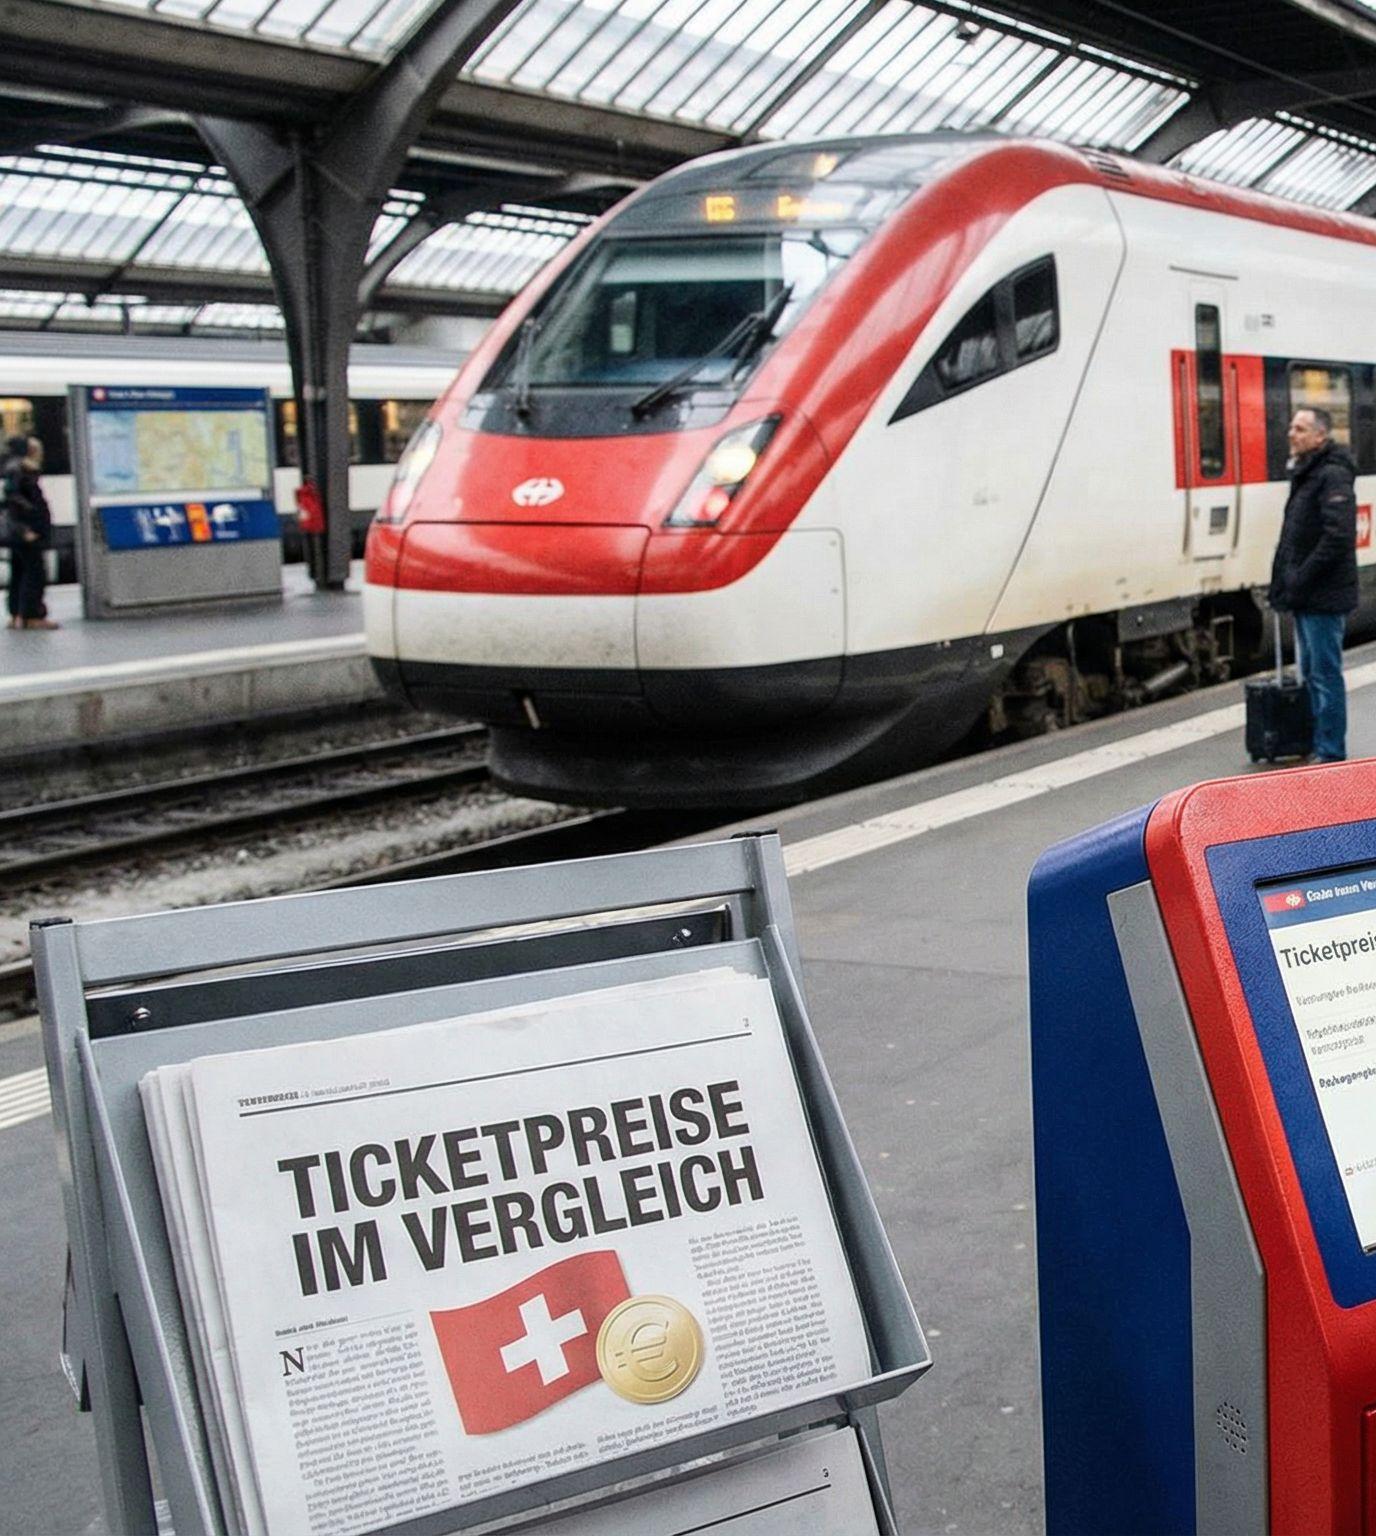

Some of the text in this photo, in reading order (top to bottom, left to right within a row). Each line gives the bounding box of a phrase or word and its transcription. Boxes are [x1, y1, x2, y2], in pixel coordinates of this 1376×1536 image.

[277, 1079, 751, 1219] TICKETPREISE
[292, 1145, 764, 1297] IM VERGLEICH
[279, 1346, 305, 1377] N
